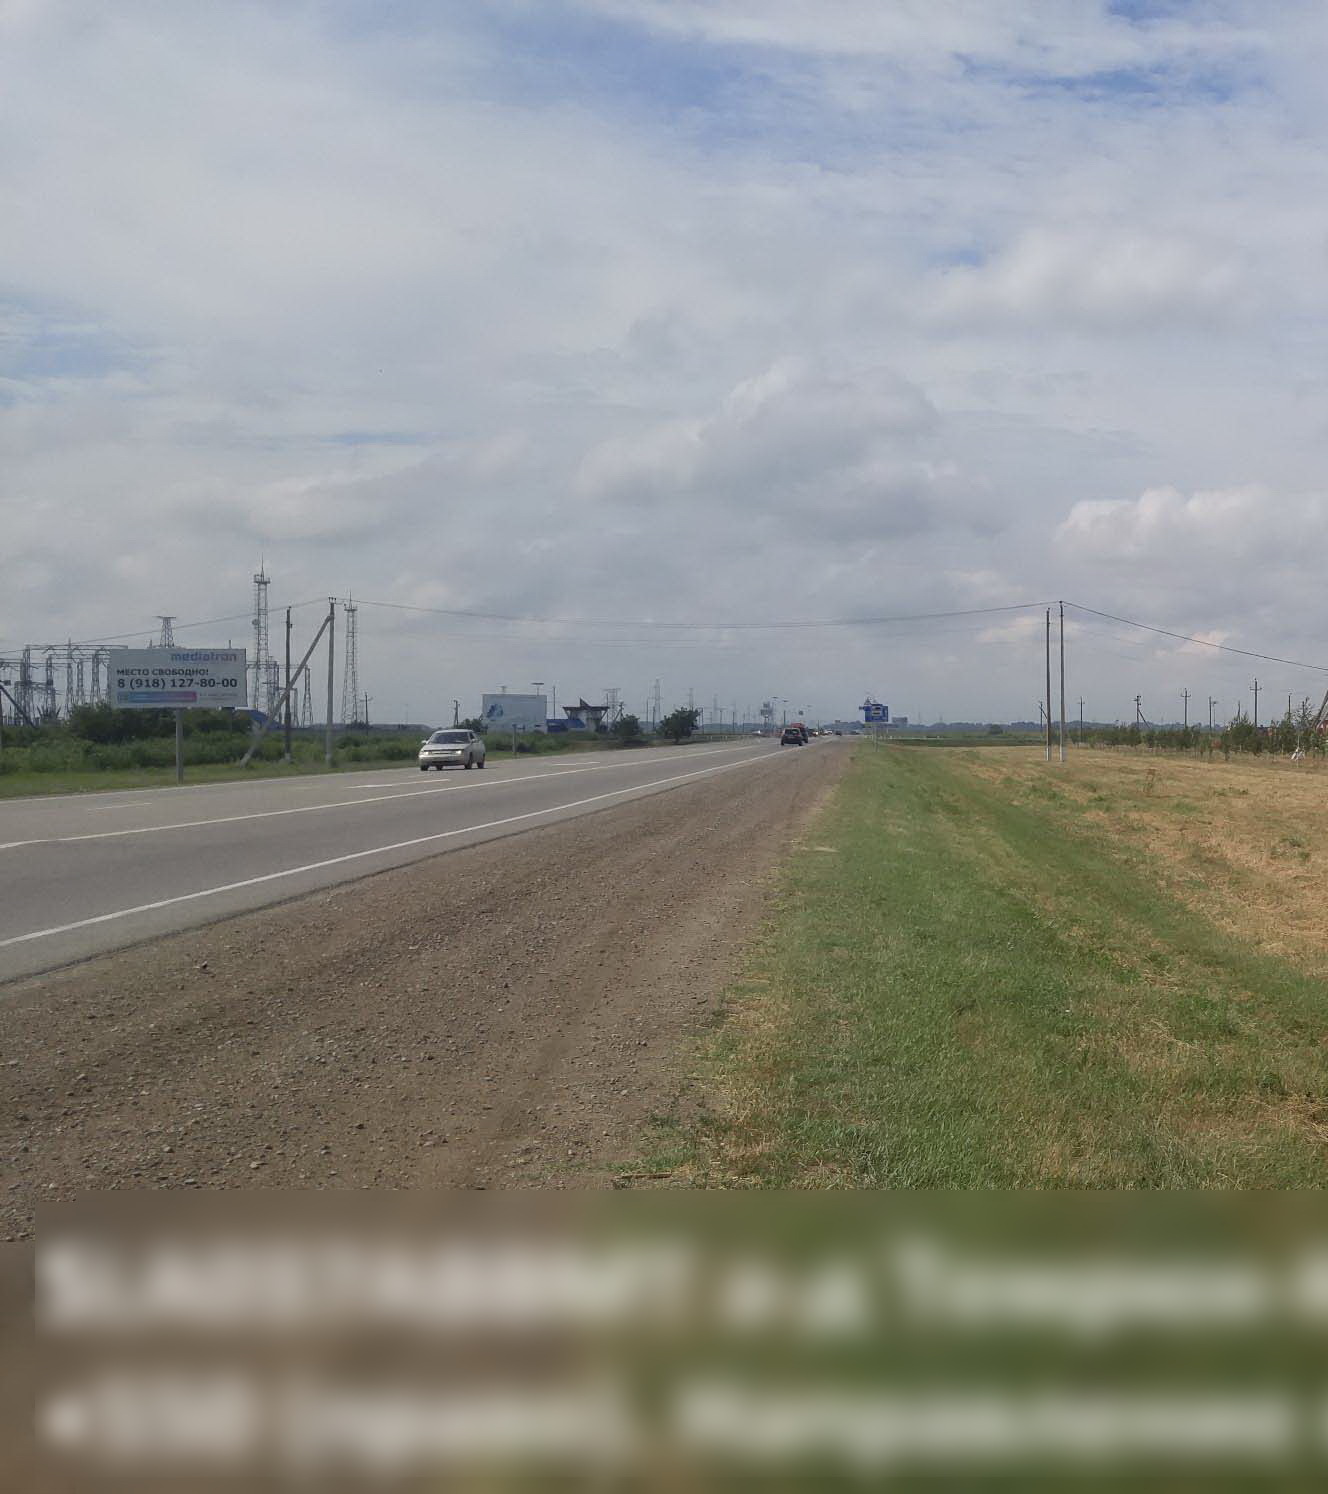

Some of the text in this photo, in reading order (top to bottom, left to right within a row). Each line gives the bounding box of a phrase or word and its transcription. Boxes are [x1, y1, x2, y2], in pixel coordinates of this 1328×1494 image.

[171, 652, 237, 662] mediatron
[117, 668, 209, 677] МЕСТО СВОБОДНО!
[118, 678, 238, 690] 8 (918) 127-80-00
